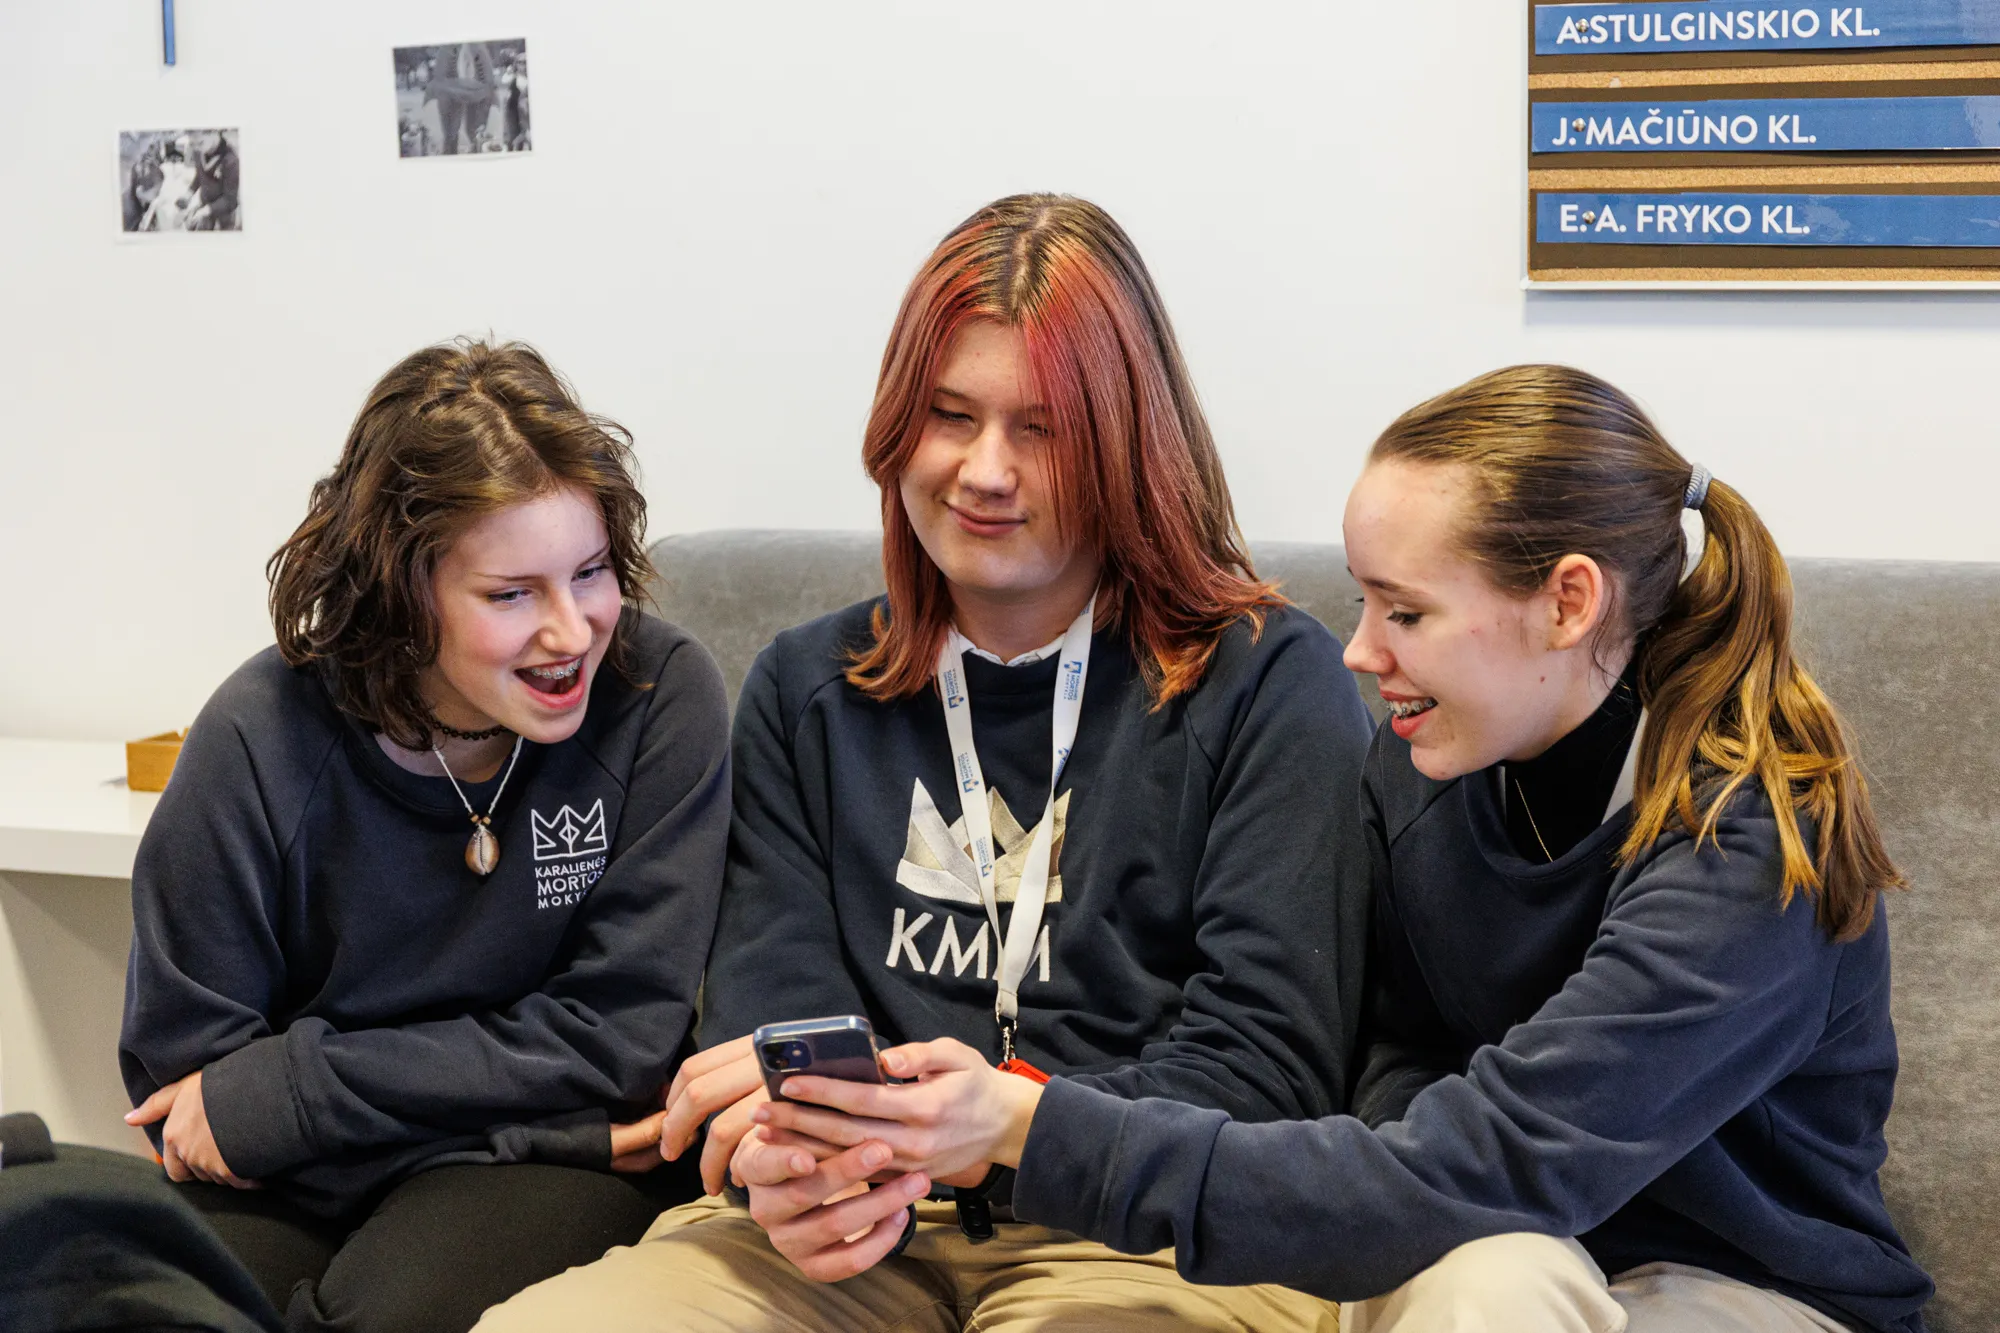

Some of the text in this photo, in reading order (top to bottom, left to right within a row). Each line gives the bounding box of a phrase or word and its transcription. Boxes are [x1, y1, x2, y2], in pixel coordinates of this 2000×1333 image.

[1831, 8, 1881, 38] KL.
[1552, 108, 1817, 146] J. MAČIŪNO KL.
[1560, 204, 1811, 235] E. A. FRYKO KL.
